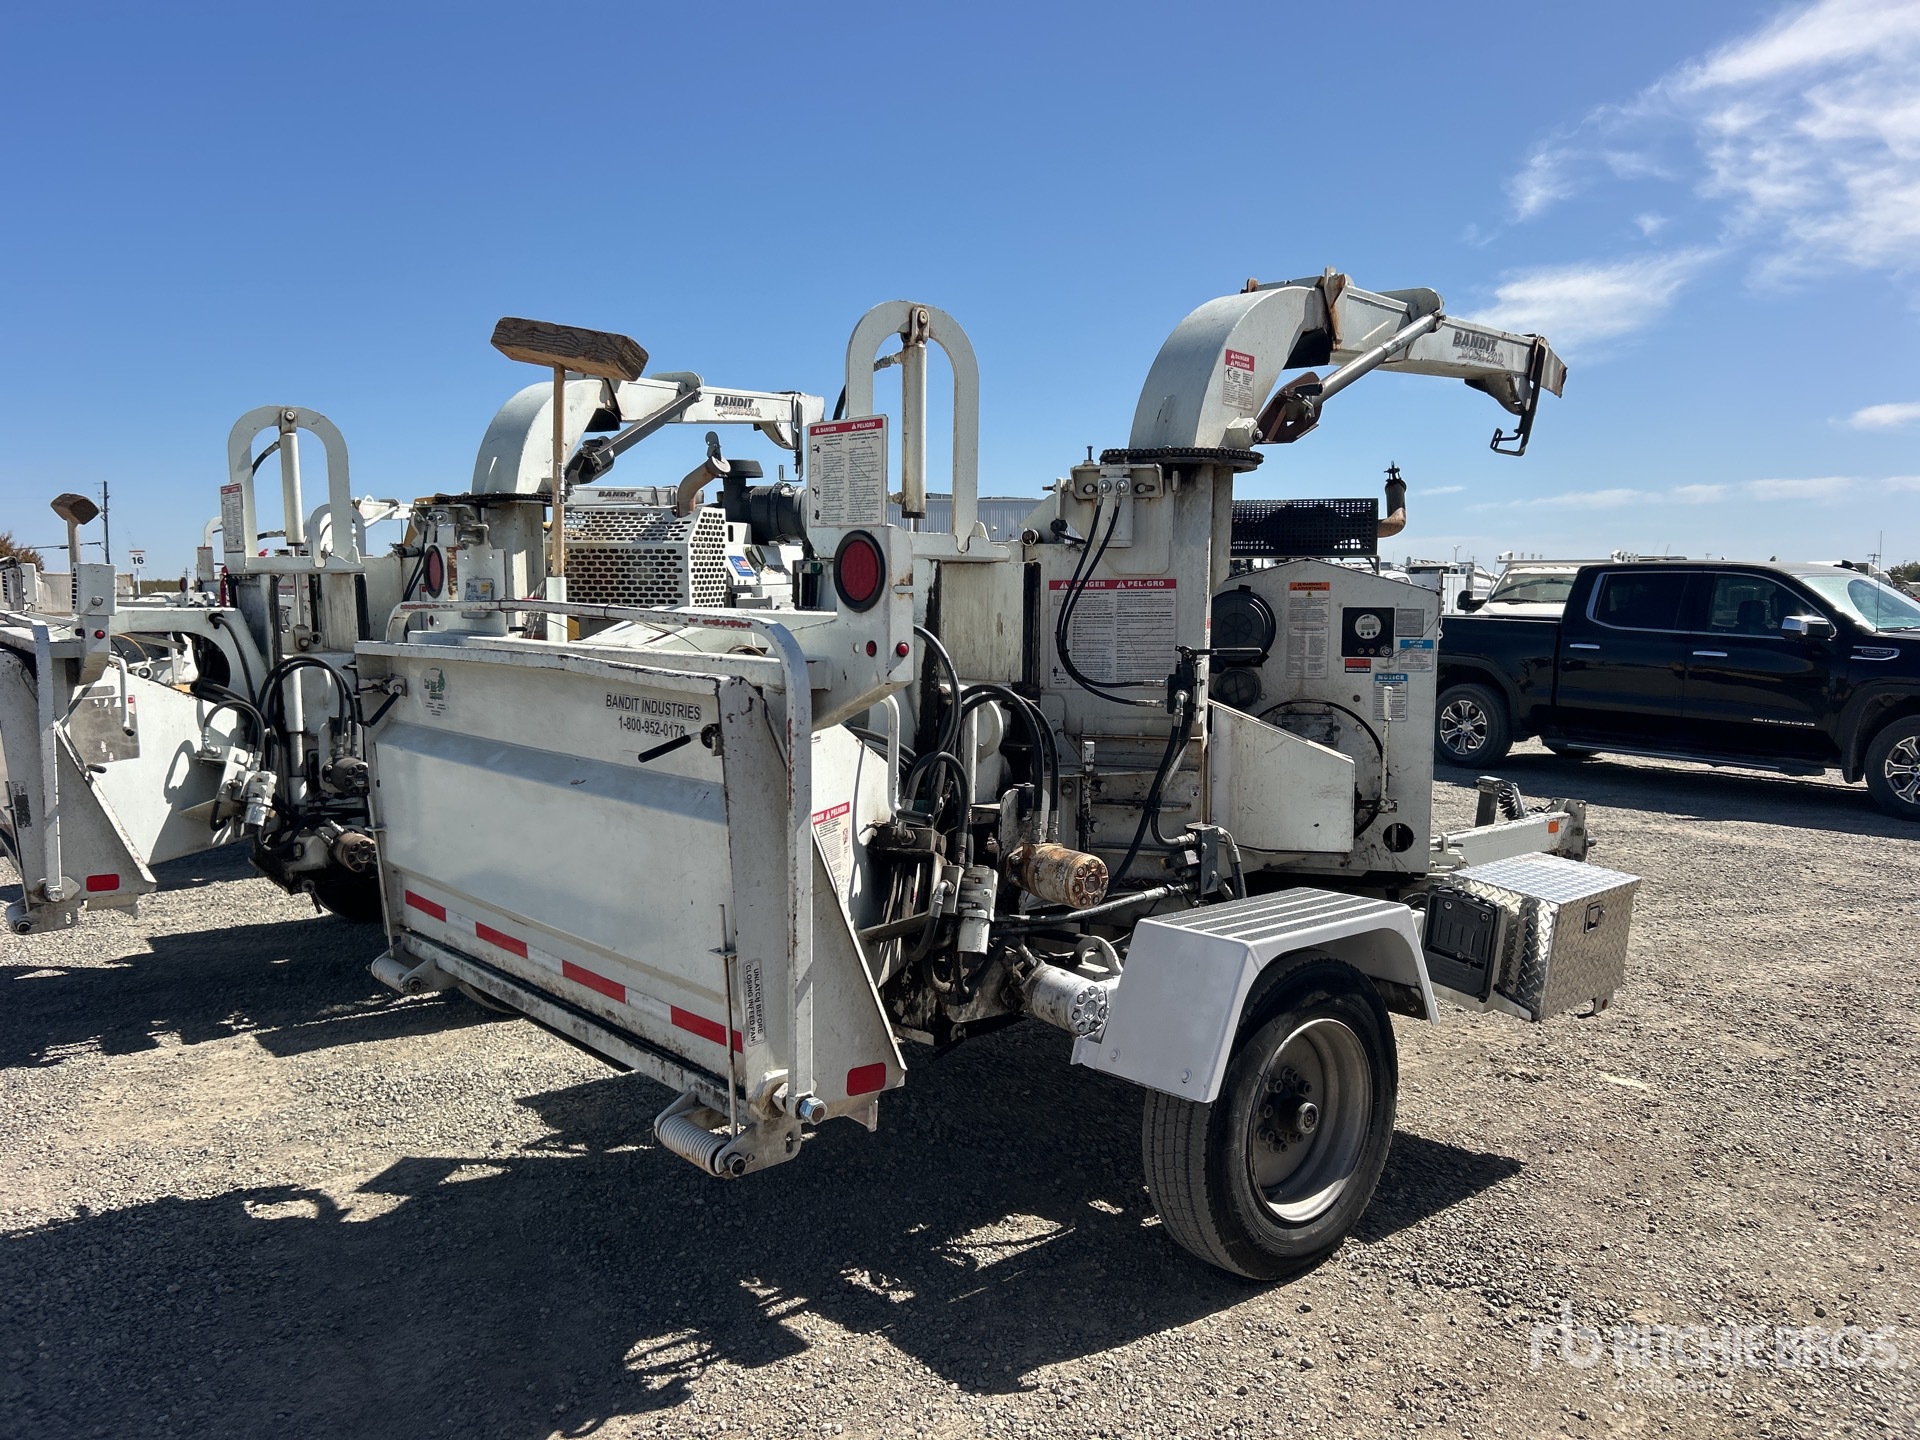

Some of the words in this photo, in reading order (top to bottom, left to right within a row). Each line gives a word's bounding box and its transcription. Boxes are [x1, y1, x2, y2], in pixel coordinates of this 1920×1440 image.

[1453, 331, 1498, 352] BANDIT
[714, 395, 754, 408] BANDIT
[856, 421, 876, 429] PELIGRO
[132, 556, 144, 565] 16
[606, 694, 640, 711] BANDIT
[642, 700, 701, 720] INDUSTRIES
[618, 716, 686, 738] 1-800-952-0178
[1752, 717, 1816, 727] SIERRA
[745, 964, 754, 998] CLOSING
[753, 968, 761, 1003] UNLATCH
[748, 998, 756, 1026] INFEED
[756, 1003, 764, 1034] BEFORE
